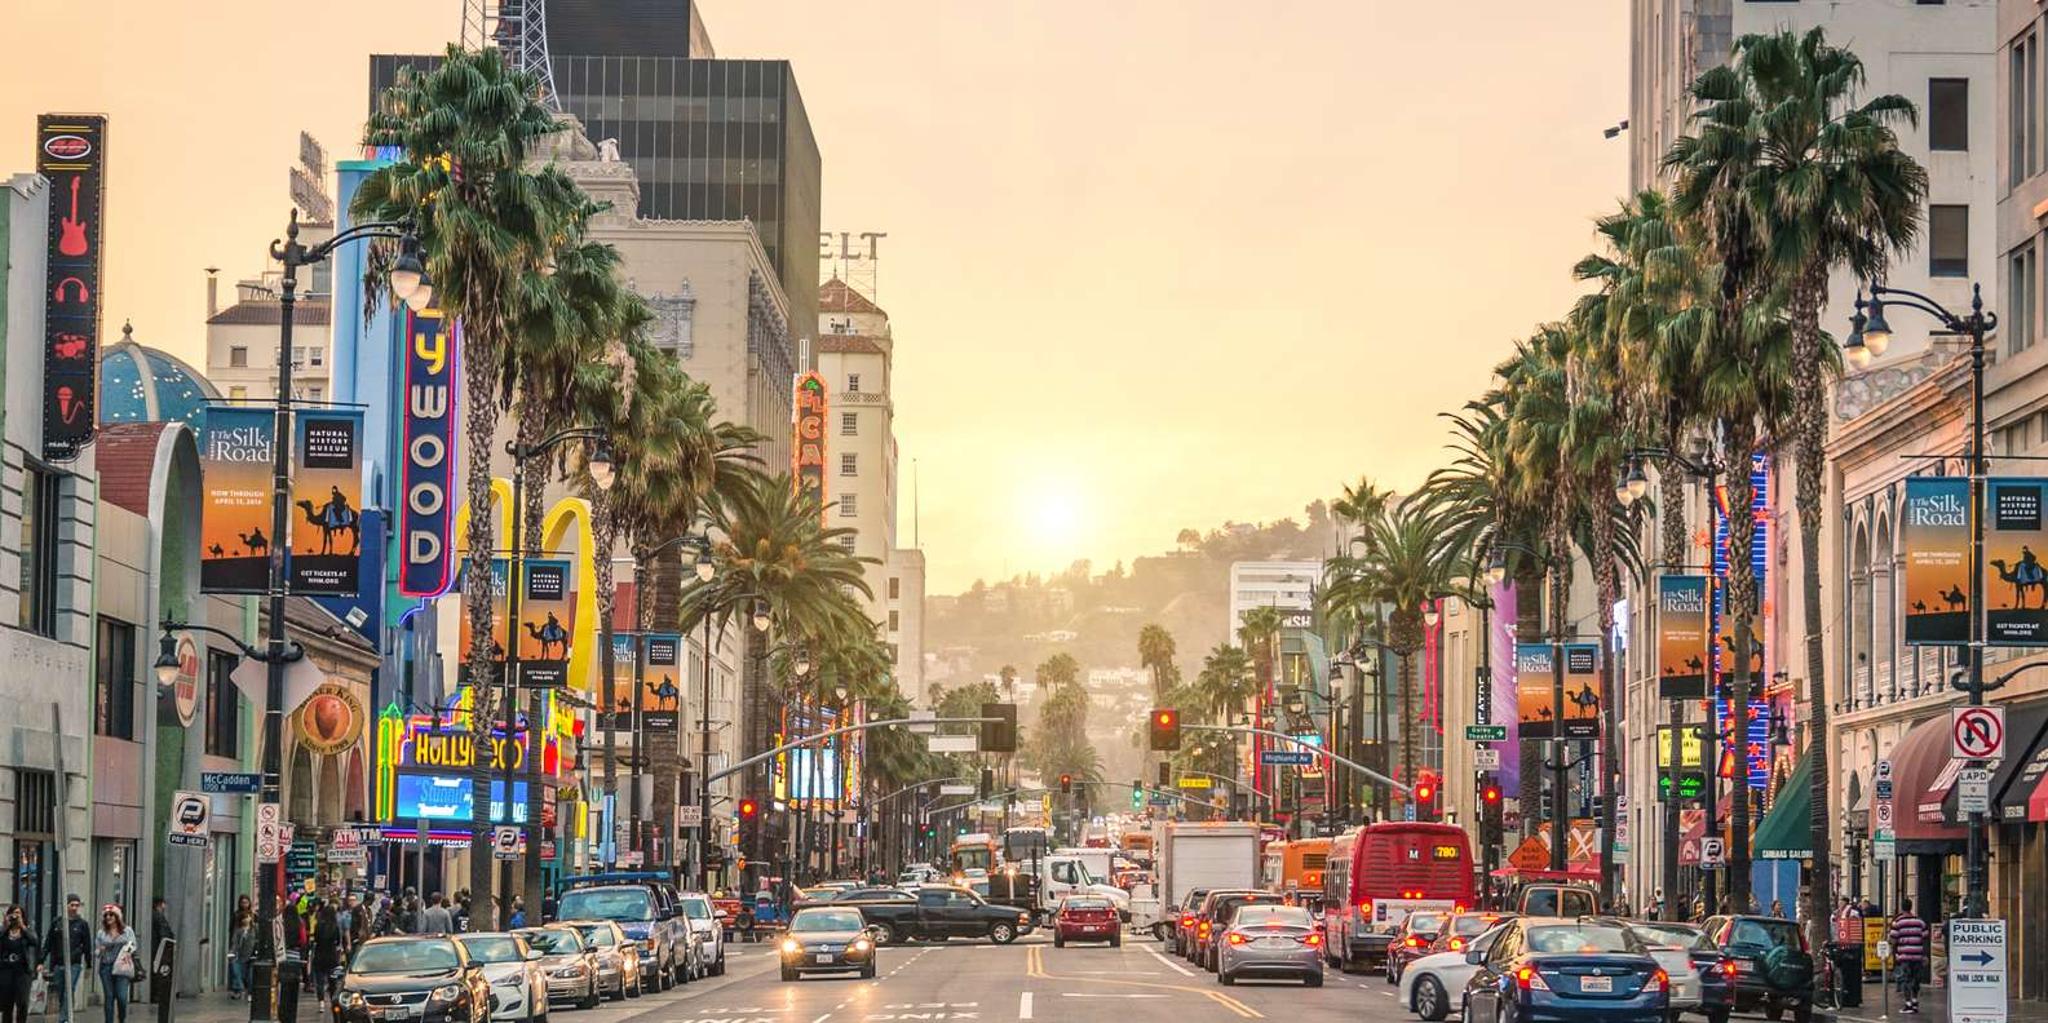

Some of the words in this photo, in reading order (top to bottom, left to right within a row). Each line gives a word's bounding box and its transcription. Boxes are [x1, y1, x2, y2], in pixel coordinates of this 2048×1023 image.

[217, 430, 232, 440] The
[231, 427, 266, 447] Silk
[409, 308, 447, 565] YWOOD
[217, 440, 270, 462] Road
[1929, 494, 1960, 512] Silk
[1916, 506, 1965, 526] Road
[1677, 588, 1698, 602] Silk
[1668, 597, 1703, 612] Road
[1530, 653, 1549, 664] Silk
[1522, 661, 1552, 673] Road
[415, 732, 523, 769] HOLLYOOD
[1264, 754, 1297, 763] Highland
[203, 774, 250, 785] McCadden
[1959, 771, 1987, 781] LAPD
[171, 835, 186, 844] PAY
[186, 837, 206, 846] HERE
[335, 831, 357, 843] ATM
[328, 849, 361, 858] INTERNET
[1436, 846, 1456, 859] 780
[1953, 924, 2002, 933] PUBLIC
[1953, 934, 2002, 944] PARKING
[1956, 974, 1969, 983] PARK
[1971, 974, 1984, 983] LOCK
[1986, 974, 2000, 983] WALK
